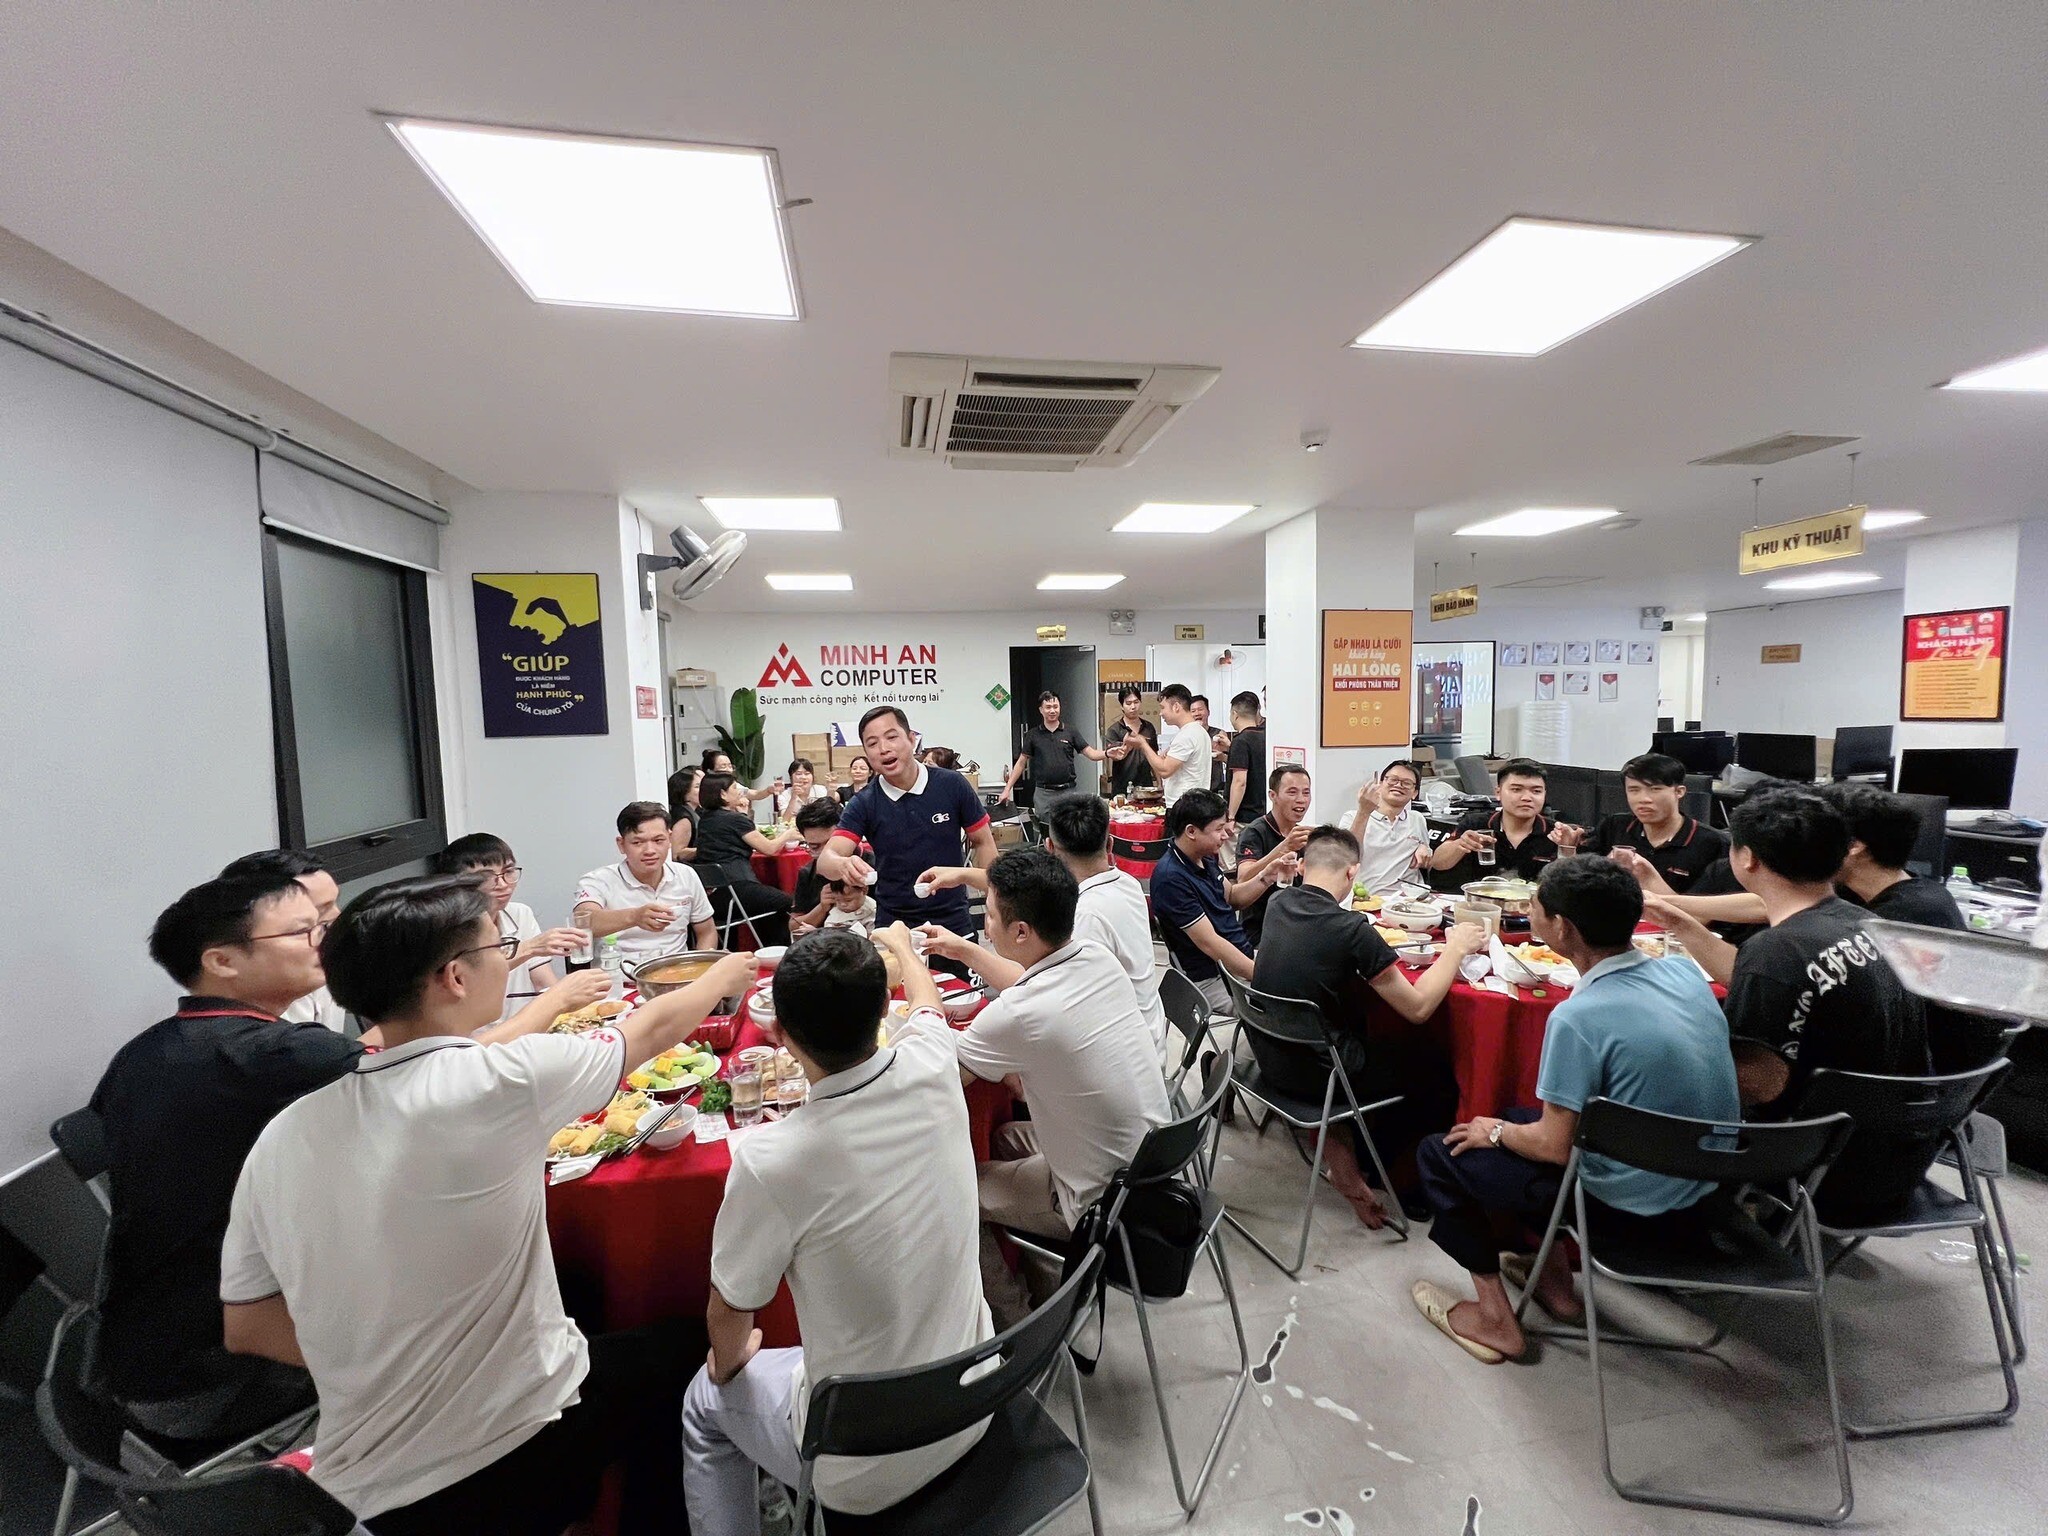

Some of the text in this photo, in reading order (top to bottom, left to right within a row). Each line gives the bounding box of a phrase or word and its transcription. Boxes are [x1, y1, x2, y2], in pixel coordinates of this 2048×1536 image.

[1752, 524, 1852, 557] KHU KỸ THUẬT
[1433, 603, 1445, 613] KHU
[1445, 599, 1457, 611] BẢO
[1333, 636, 1402, 651] GẶP NHAU LÀ CƯỜI
[1916, 636, 1996, 649] KHÁCH HÀNG
[820, 644, 936, 666] MINH AN
[1332, 660, 1402, 676] HÀI LÒNG
[820, 668, 938, 687] COMPUTER
[516, 689, 572, 699] HẠNH PHÚC
[759, 694, 779, 704] Sức
[782, 694, 807, 706] mạnh
[809, 693, 833, 705] công
[835, 693, 858, 705] nghệ
[864, 691, 880, 703] Kết
[882, 691, 896, 702] nối
[898, 693, 927, 703] tương
[515, 700, 575, 716] CỦA CHÚNG TÔI
